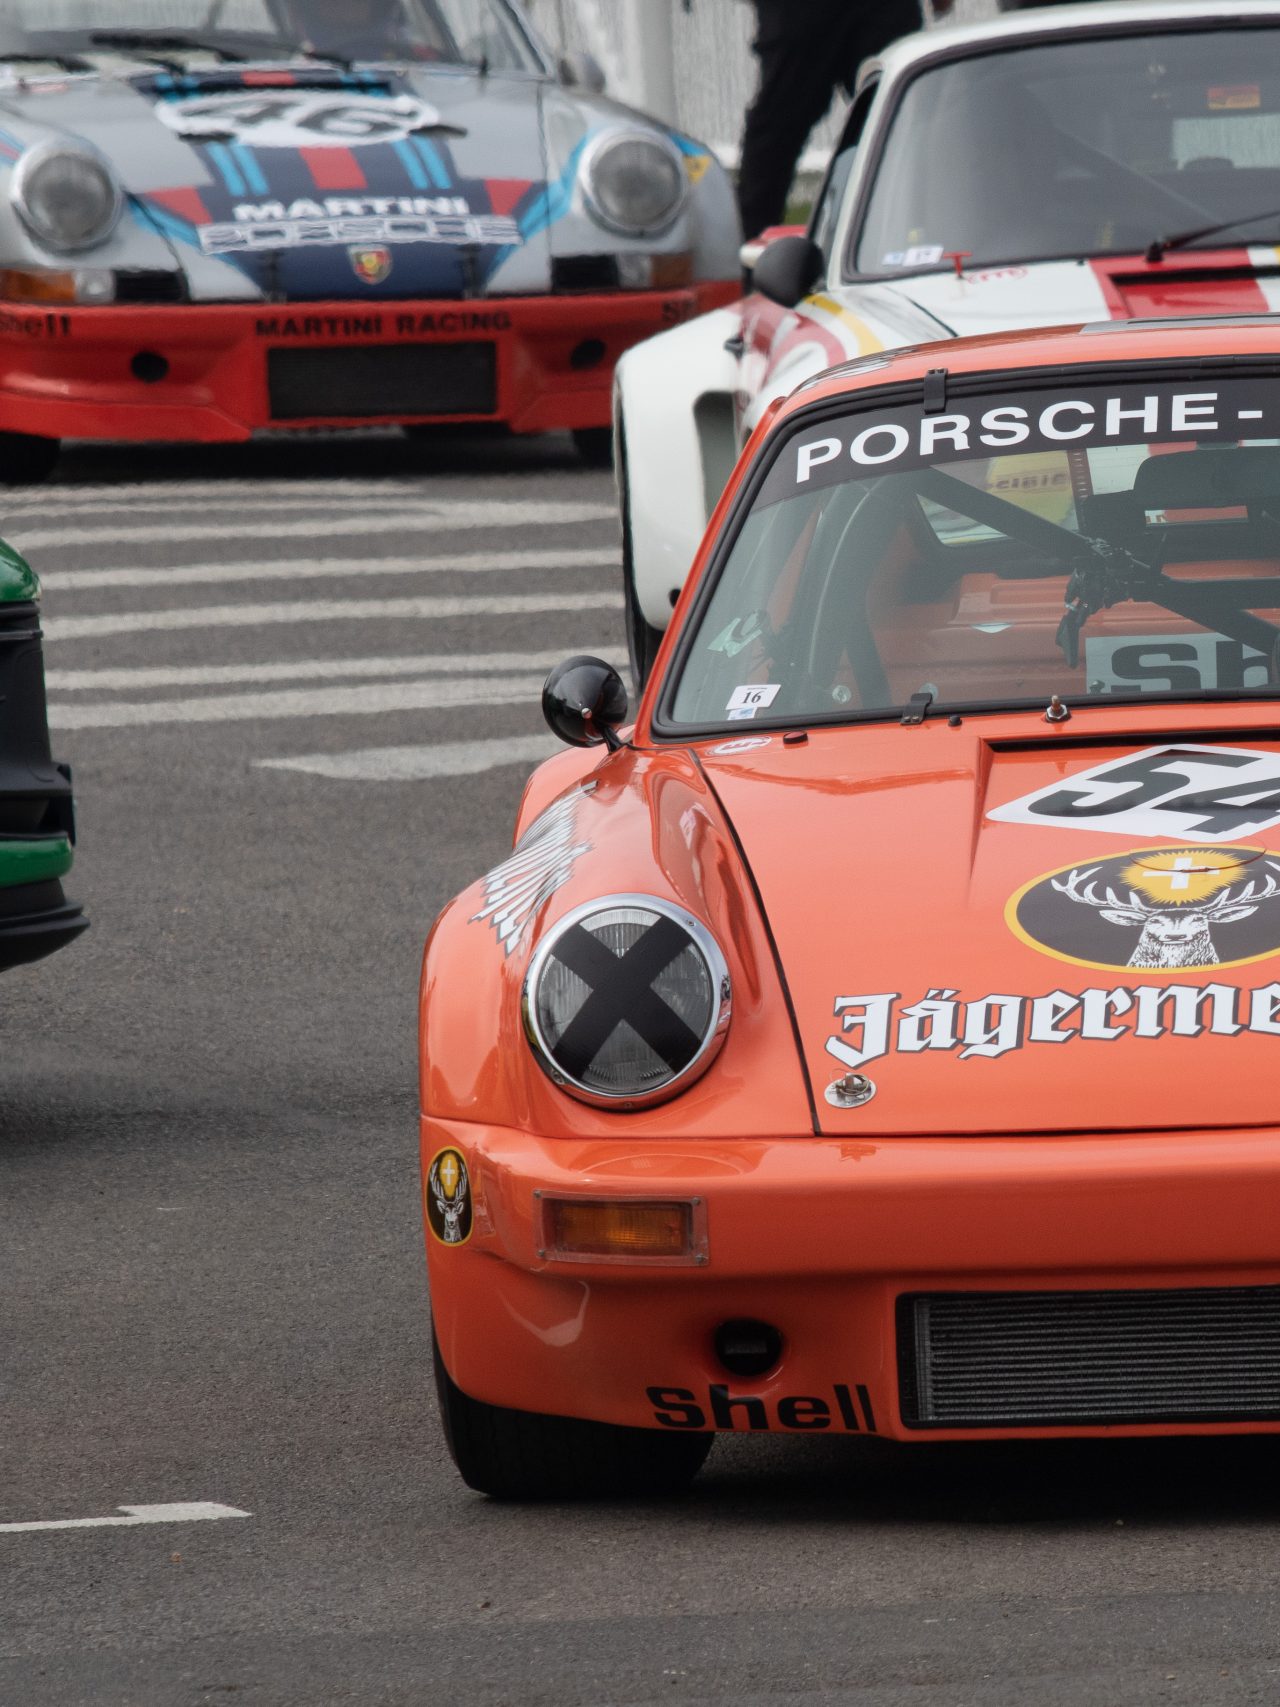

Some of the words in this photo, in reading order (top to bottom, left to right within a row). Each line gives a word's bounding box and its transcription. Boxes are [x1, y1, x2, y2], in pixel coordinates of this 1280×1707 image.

[176, 98, 420, 137] 46
[232, 196, 470, 222] MARTINI
[198, 213, 523, 254] PORSCHE
[255, 309, 382, 337] MARTINI
[396, 302, 512, 333] RACING
[796, 390, 1218, 482] PORSCHE
[741, 690, 765, 704] 16
[648, 1383, 878, 1434] Shell
